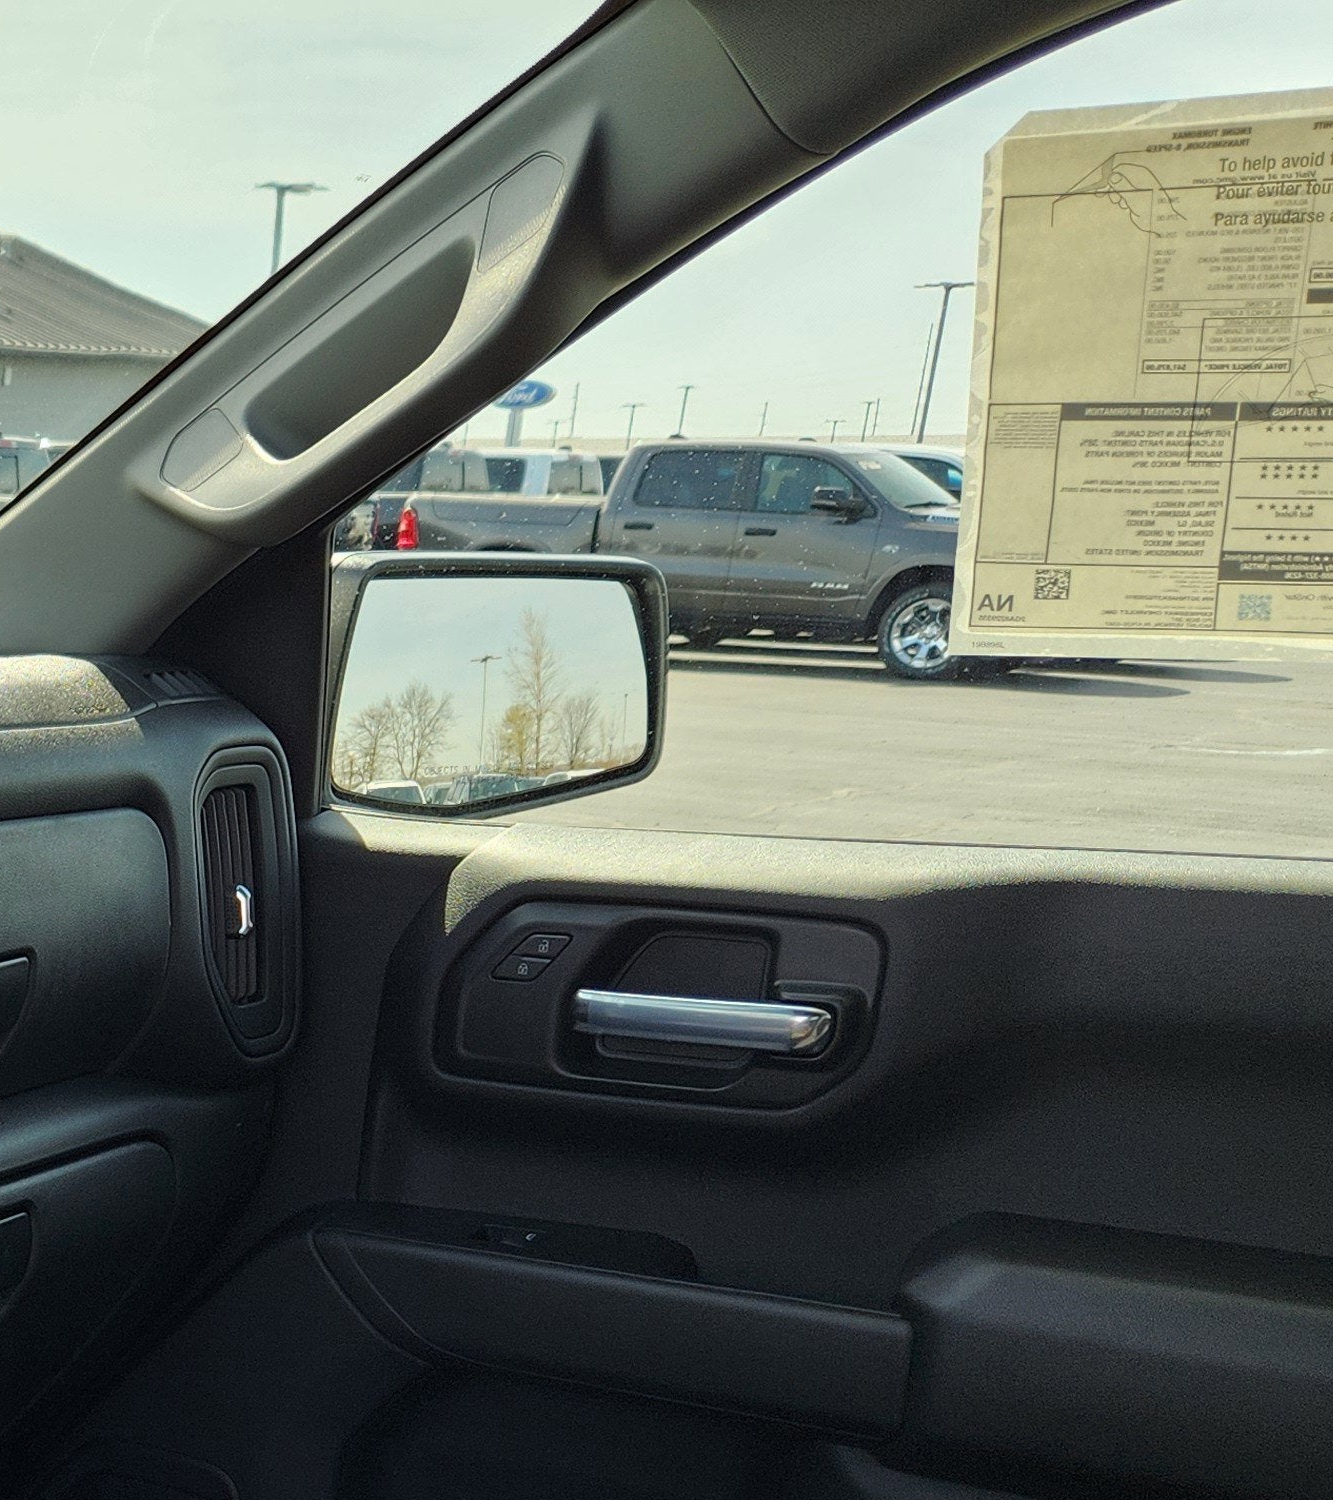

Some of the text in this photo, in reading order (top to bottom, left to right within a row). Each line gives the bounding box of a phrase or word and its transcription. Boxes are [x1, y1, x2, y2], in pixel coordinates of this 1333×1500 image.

[1220, 152, 1325, 172] To help avoid
[1216, 186, 1250, 200] Pour
[1306, 182, 1333, 195] tou
[1214, 211, 1324, 227] Para ayudarse
